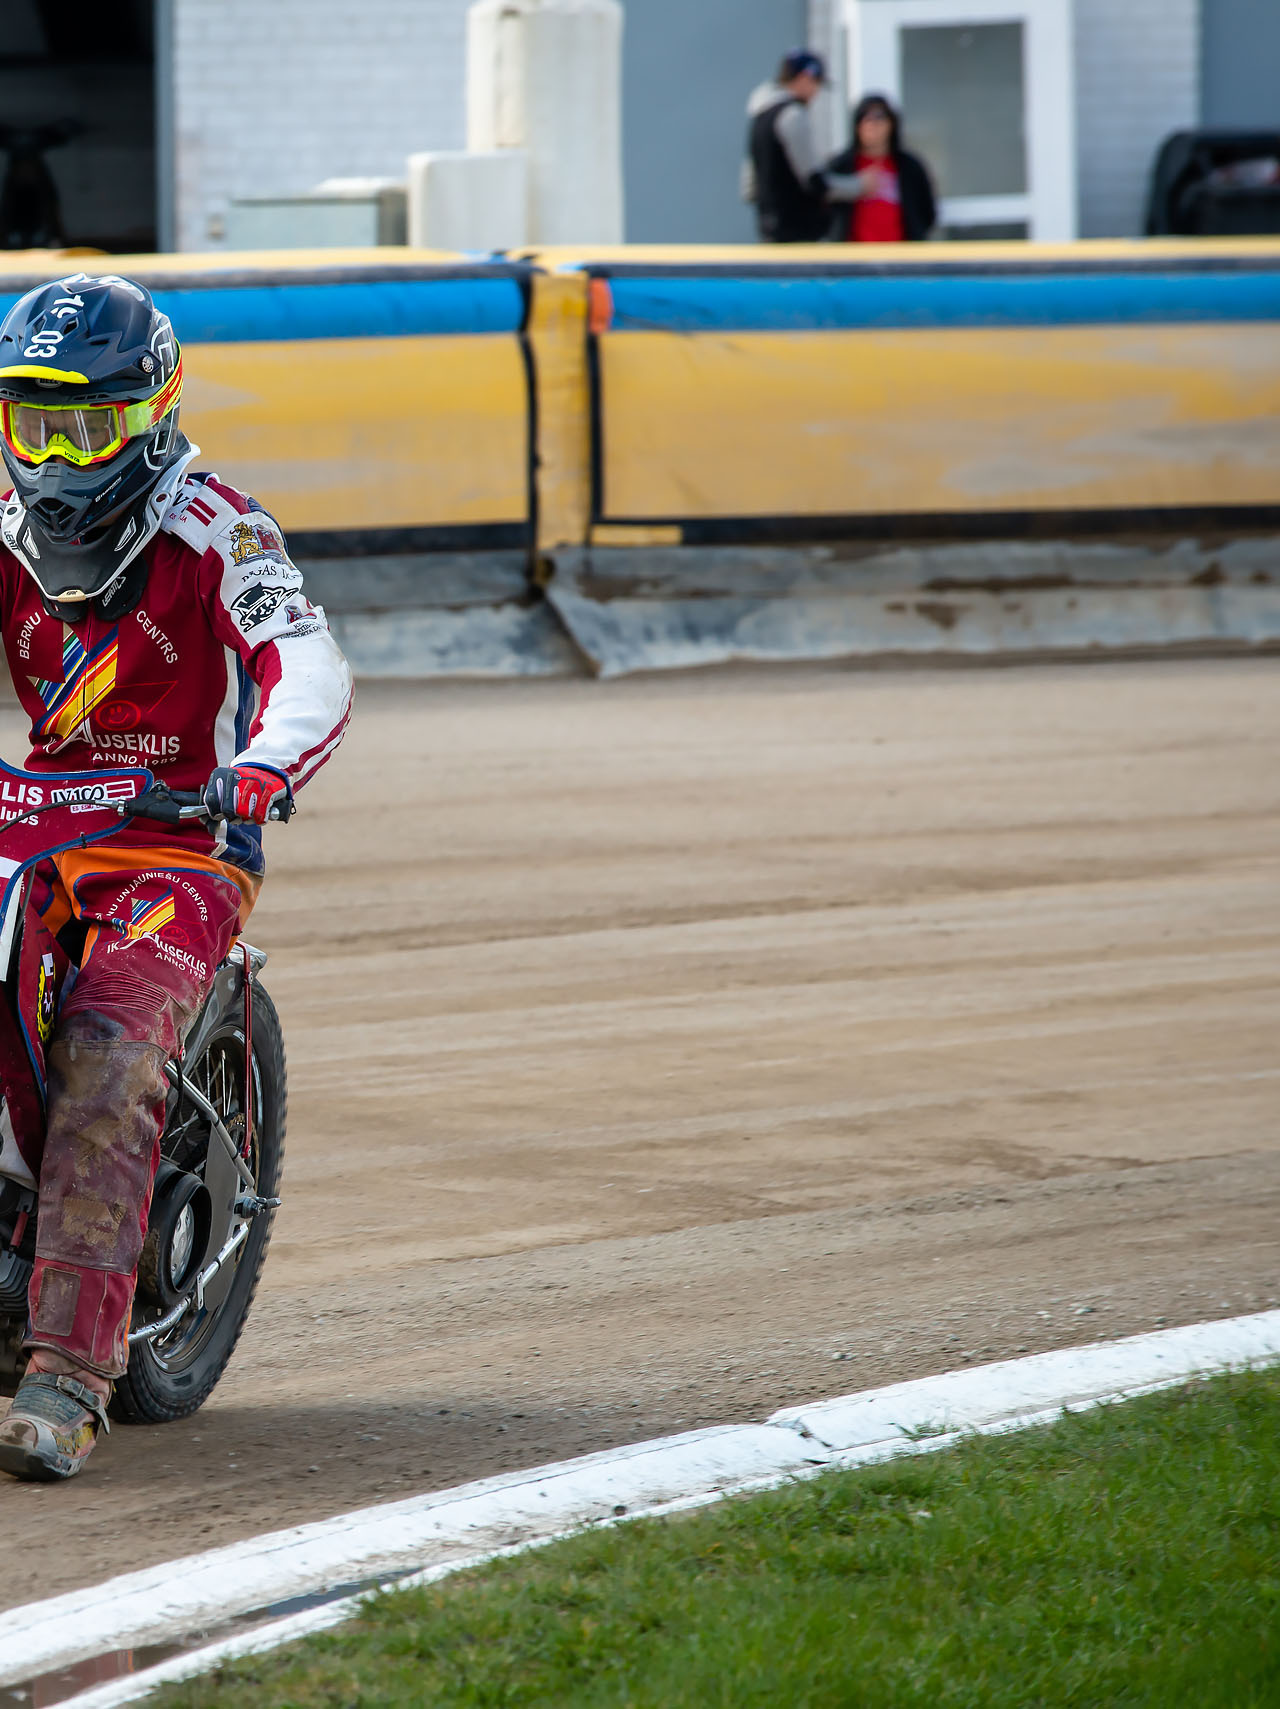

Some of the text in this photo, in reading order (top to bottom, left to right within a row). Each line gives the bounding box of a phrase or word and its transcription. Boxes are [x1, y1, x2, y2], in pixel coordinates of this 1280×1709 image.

[64, 450, 81, 463] VISTA
[17, 611, 42, 660] BĒRNU
[136, 609, 179, 665] CENTRS
[70, 717, 181, 756] AUSEKLIS
[92, 752, 138, 765] ANNO
[181, 881, 208, 922] CENTRS
[144, 932, 207, 976] AUSEKLIS
[155, 951, 186, 971] ANNO
